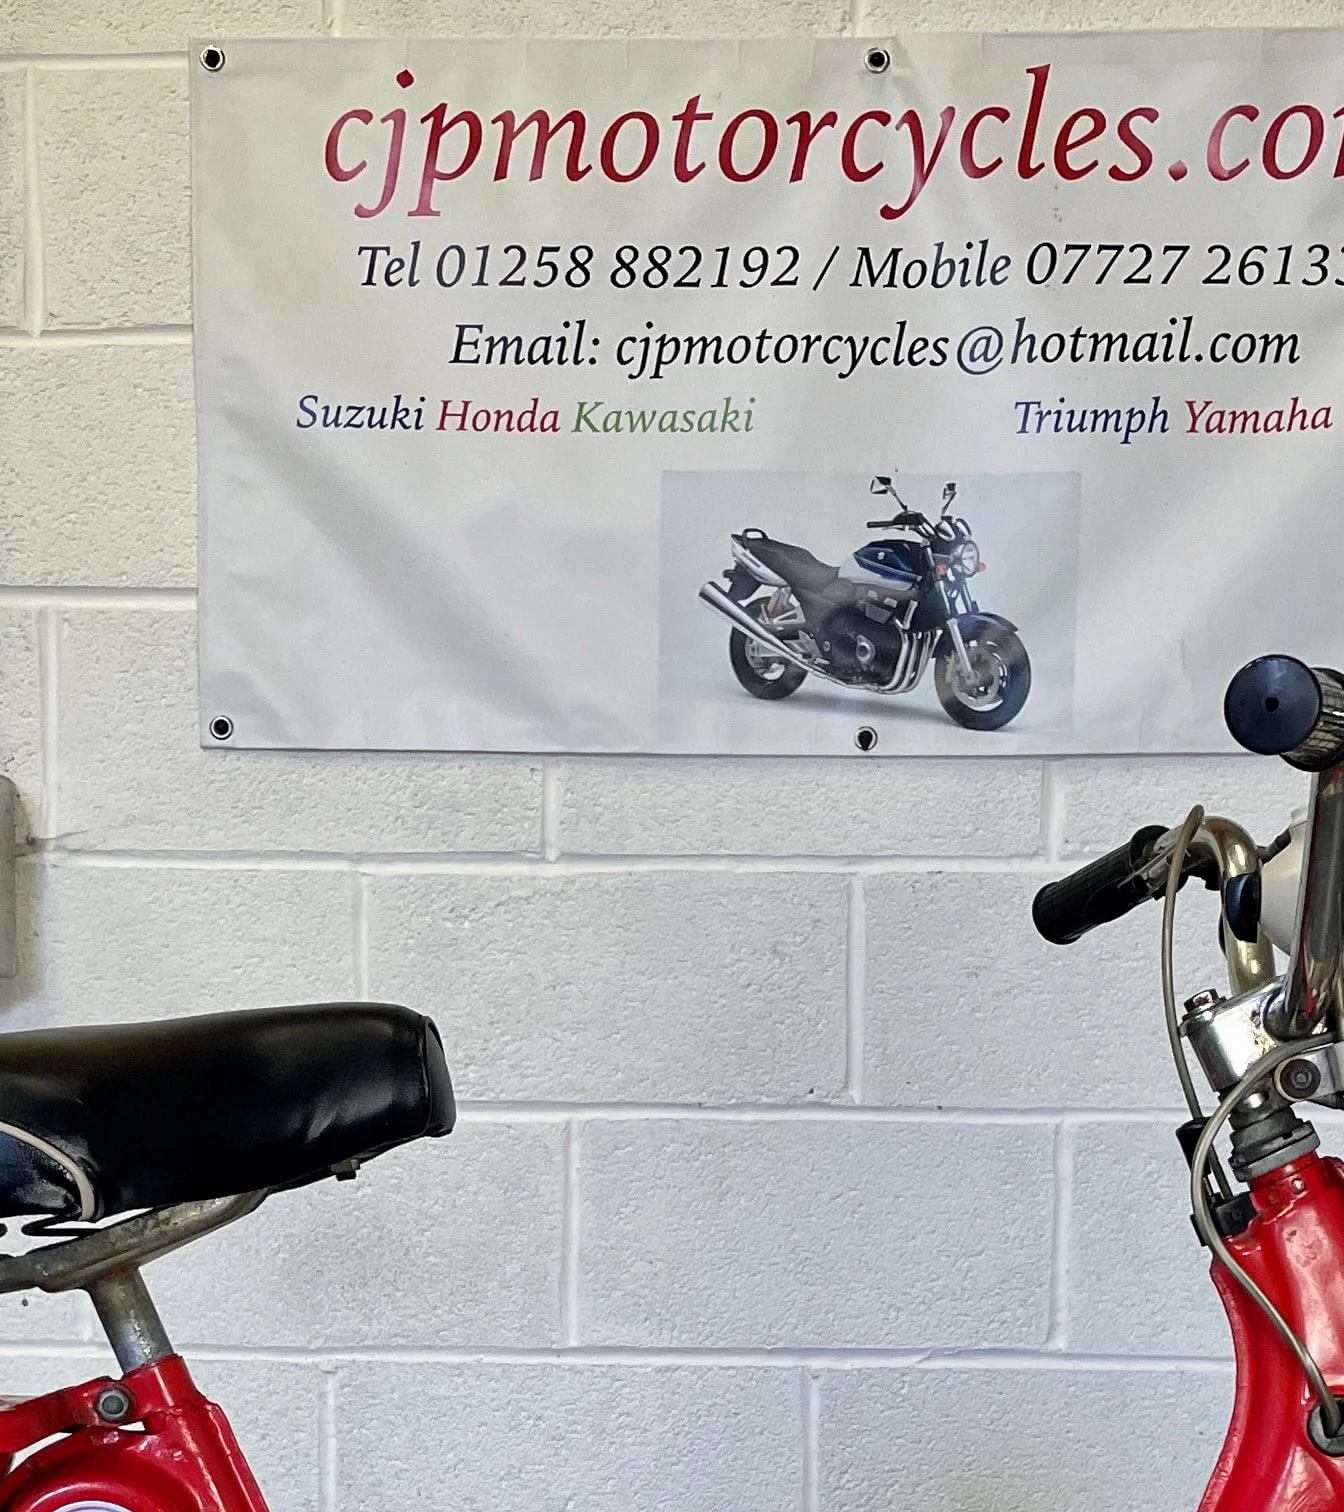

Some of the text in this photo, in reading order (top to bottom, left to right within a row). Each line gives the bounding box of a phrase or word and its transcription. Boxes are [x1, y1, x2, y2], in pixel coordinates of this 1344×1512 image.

[358, 240, 420, 288] Tel
[436, 245, 594, 288] 01258
[610, 245, 800, 288] 882192
[813, 246, 840, 291] /
[849, 239, 1012, 289] Mobile
[1027, 242, 1191, 286] 07727
[448, 315, 1301, 380] Email: cjpmotorcycles@hotmail.com
[297, 394, 755, 433] Suzuki Honda Kawasaki
[1014, 396, 1169, 444] Triumph
[1185, 396, 1333, 433] Yamaha
